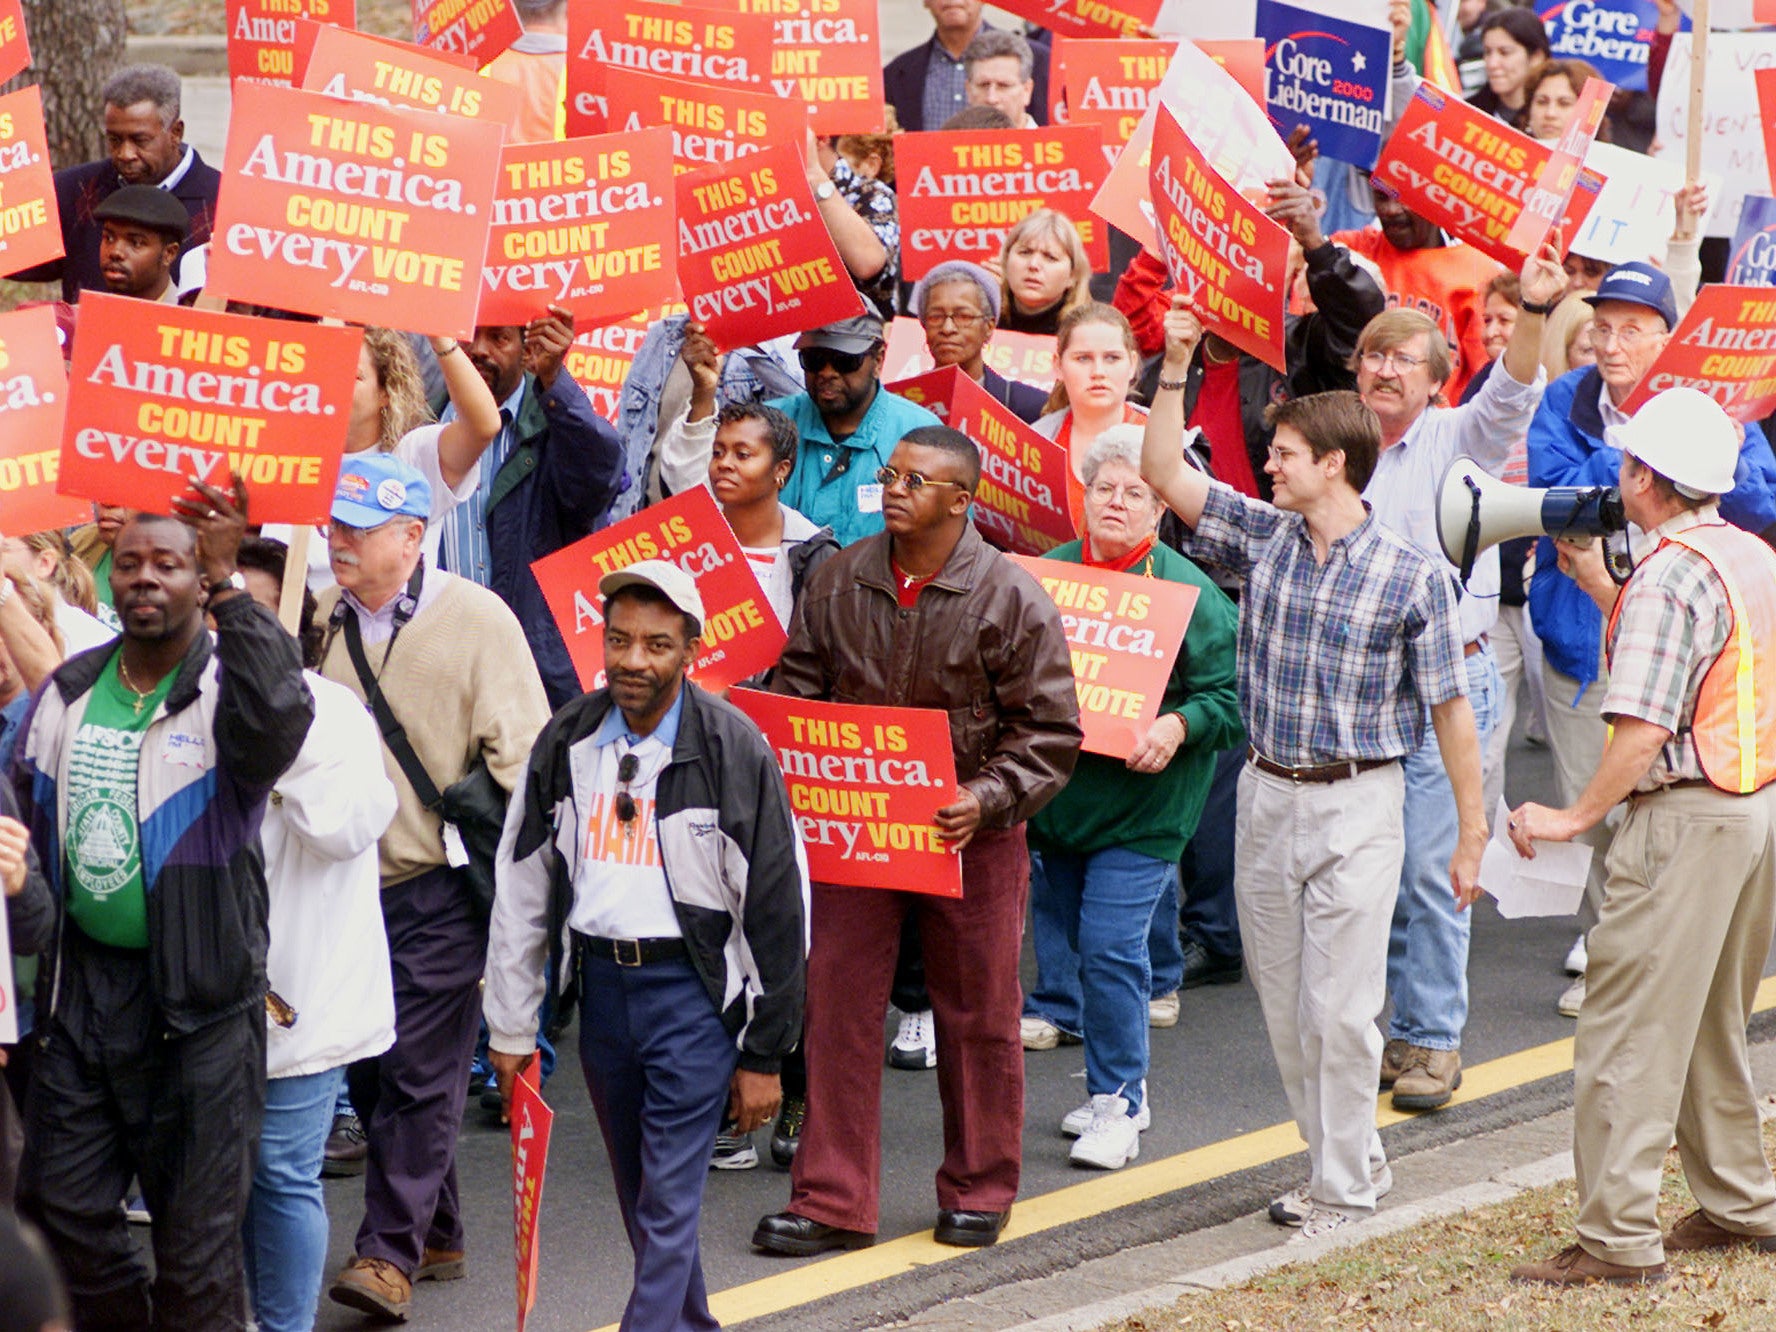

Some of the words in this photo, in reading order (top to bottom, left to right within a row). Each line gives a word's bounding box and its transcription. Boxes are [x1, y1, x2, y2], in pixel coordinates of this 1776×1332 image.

[625, 13, 694, 46] THIS
[704, 23, 735, 51] IS
[773, 9, 869, 44] rica.
[1076, 0, 1142, 37] VOTE
[1561, 0, 1640, 36] Gore
[257, 47, 294, 75] COU
[578, 28, 761, 83] America.
[1275, 38, 1333, 86] Gore
[1332, 79, 1374, 102] 2000
[375, 61, 442, 105] THIS
[449, 86, 483, 116] IS
[799, 76, 870, 102] VOTE
[1265, 66, 1382, 135] Lieberman
[308, 113, 396, 159] THIS
[408, 132, 450, 168] IS
[660, 95, 725, 132] THIS
[737, 108, 768, 137] IS
[506, 157, 587, 191] THIS
[598, 150, 632, 180] IS
[952, 143, 1023, 169] THIS
[1034, 141, 1065, 166] IS
[1463, 123, 1528, 170] THIS
[239, 133, 477, 215] America.
[693, 177, 748, 215] THIS
[750, 167, 779, 197] IS
[910, 162, 1095, 198] America.
[1388, 159, 1486, 228] every
[1432, 164, 1521, 223] COUNT
[286, 195, 410, 244] COUNT
[491, 178, 664, 227] merica.
[679, 196, 813, 257] America.
[951, 200, 1046, 226] COUNT
[1154, 154, 1275, 293] America.
[1183, 156, 1226, 220] THIS
[1231, 210, 1257, 248] IS
[503, 221, 610, 261] COUNT
[1168, 213, 1231, 290] COUNT
[1587, 215, 1628, 247] IT
[226, 222, 368, 288] every
[371, 244, 464, 291] VOTE
[482, 258, 582, 301] very
[584, 243, 662, 281] VOTE
[710, 239, 784, 283] COUNT
[692, 274, 774, 323] every
[773, 257, 838, 296] VOTE
[1206, 286, 1271, 341] VOTE
[158, 325, 250, 369] THIS
[265, 341, 306, 373] IS
[1701, 354, 1776, 379] COUNT
[87, 344, 336, 416] America.
[137, 402, 267, 449] COUNT
[980, 408, 1017, 458] THIS
[1022, 441, 1042, 473] IS
[74, 427, 224, 482] every
[228, 451, 323, 485] VOTE
[592, 532, 659, 572] THIS
[658, 515, 693, 547] IS
[1041, 577, 1107, 613] THIS
[1119, 591, 1152, 620] IS
[701, 598, 765, 649] VOTE
[1061, 612, 1163, 658] erica.
[788, 715, 861, 751] THIS
[873, 725, 909, 752] IS
[778, 738, 943, 788] merica.
[792, 783, 890, 819] COUNT
[799, 813, 862, 862] ery
[866, 821, 946, 856] VOTE
